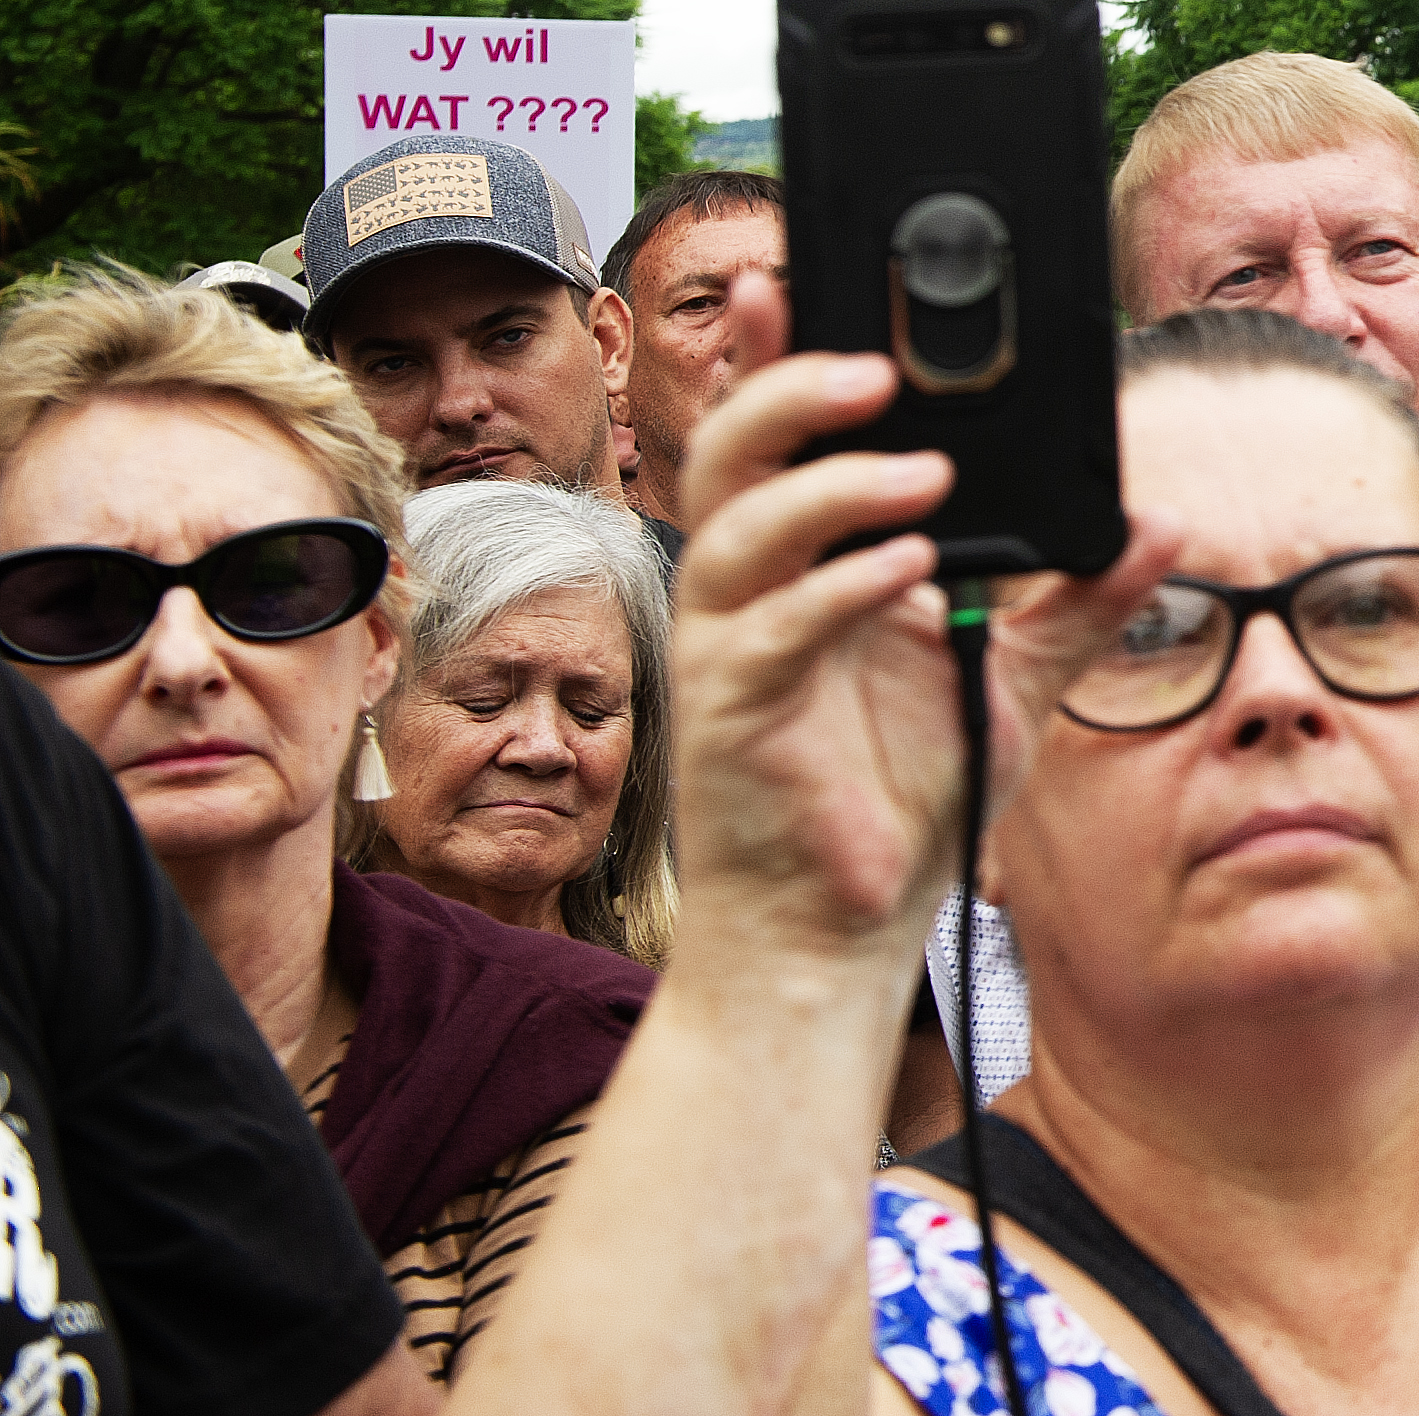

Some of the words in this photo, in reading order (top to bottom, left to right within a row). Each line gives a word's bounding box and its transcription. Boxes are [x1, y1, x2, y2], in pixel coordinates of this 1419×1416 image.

[409, 26, 467, 72] Jy
[482, 28, 550, 64] wil
[357, 93, 470, 131] WAT
[486, 95, 611, 133] ????
